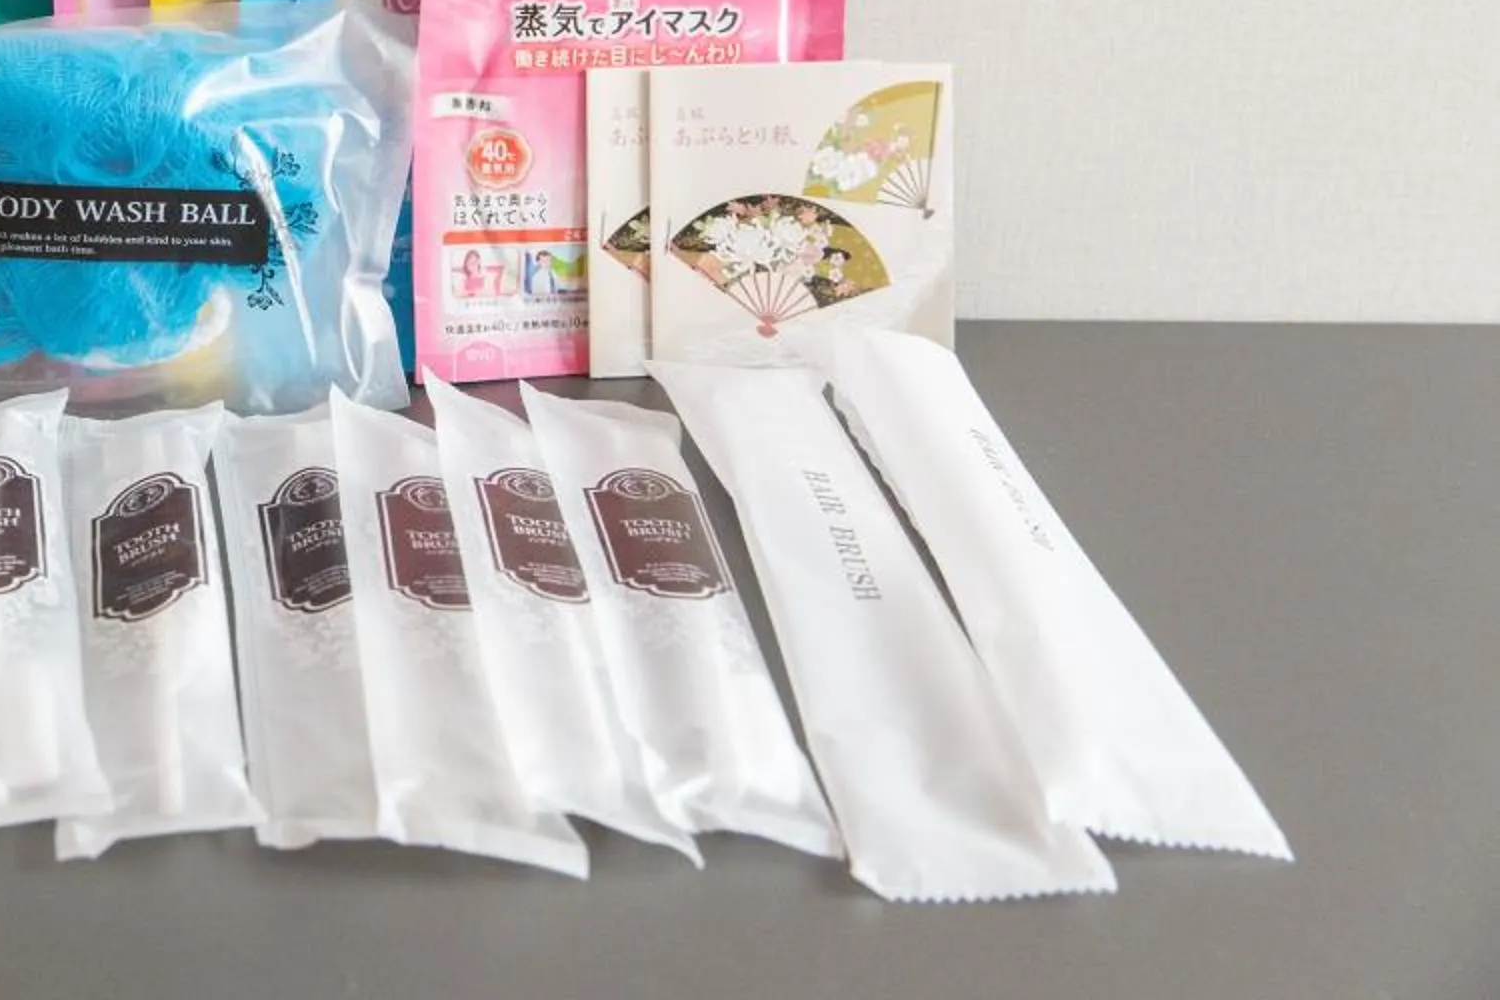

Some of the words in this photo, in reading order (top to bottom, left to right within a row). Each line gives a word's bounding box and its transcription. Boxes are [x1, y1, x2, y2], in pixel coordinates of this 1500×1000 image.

[514, 3, 739, 38] 蒸気でアイマスク
[672, 125, 799, 147] あぶらとり紙
[75, 199, 167, 223] WASH
[180, 202, 257, 225] BALL
[453, 208, 547, 225] ほぐれていく
[45, 244, 68, 253] bath
[53, 233, 68, 242] lot
[69, 233, 82, 242] of
[124, 235, 144, 245] and
[145, 235, 169, 245] kind
[171, 236, 182, 245] to
[183, 238, 208, 247] your
[618, 517, 693, 532] TOOTH
[626, 526, 692, 541] BRUSH
[801, 468, 848, 515] HAIR
[828, 524, 883, 600] BRUSH
[111, 522, 181, 554] TOOTH
[118, 532, 178, 565] BRUSH
